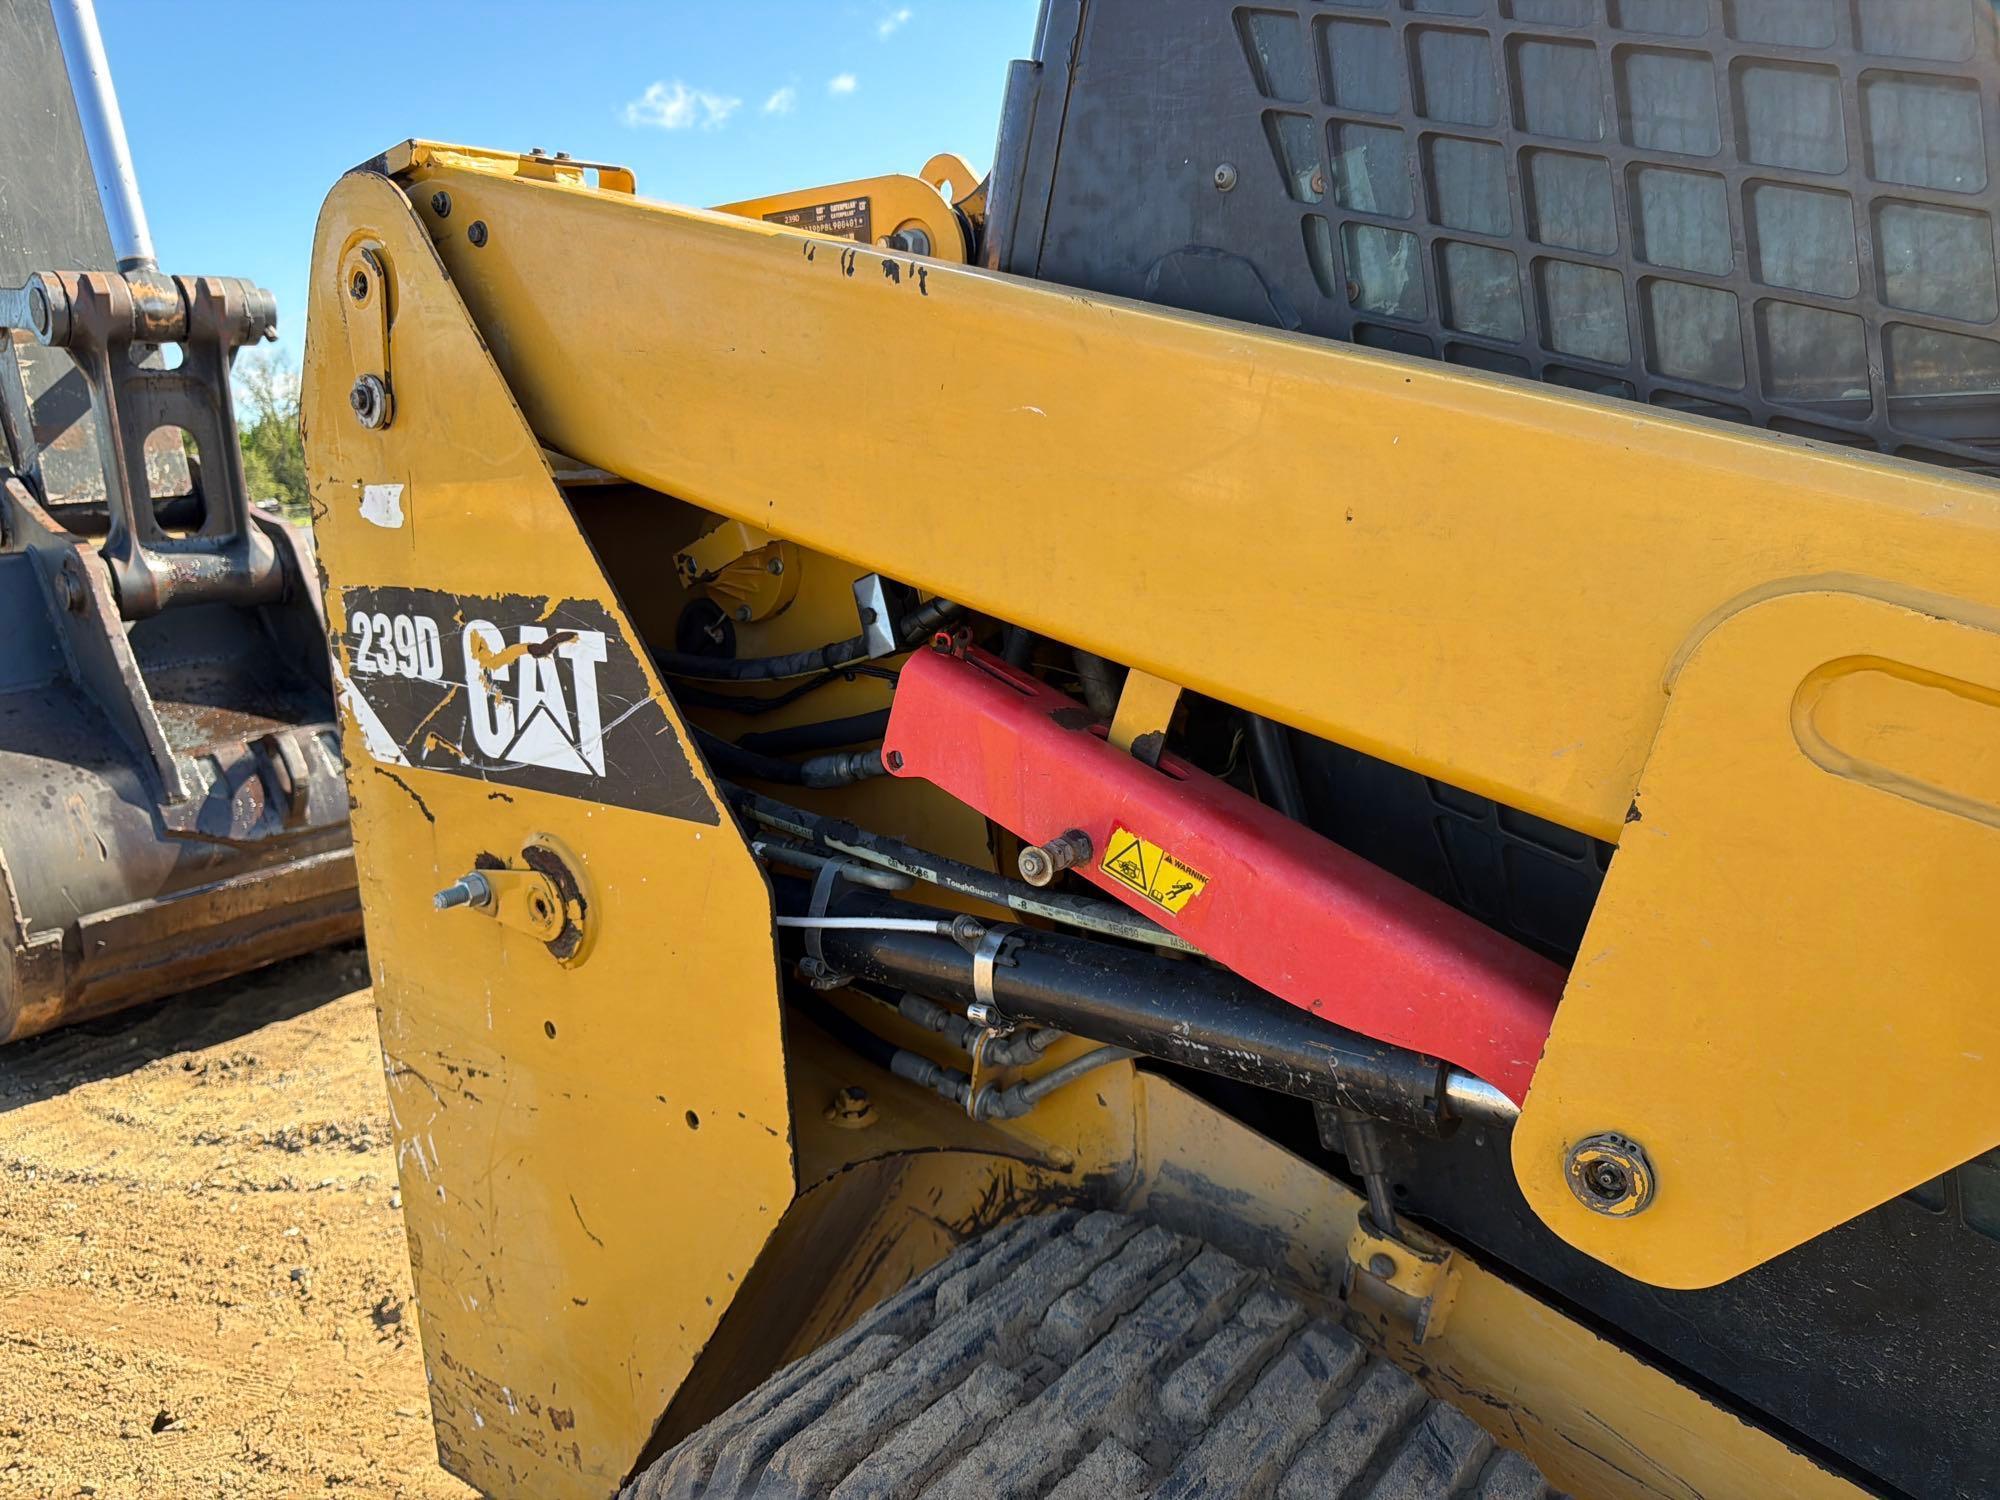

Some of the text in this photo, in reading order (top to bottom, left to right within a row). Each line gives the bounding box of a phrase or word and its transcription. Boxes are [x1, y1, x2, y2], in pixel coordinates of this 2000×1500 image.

[784, 214, 800, 224] 239D
[351, 611, 443, 681] 239D
[462, 619, 607, 778] CAT
